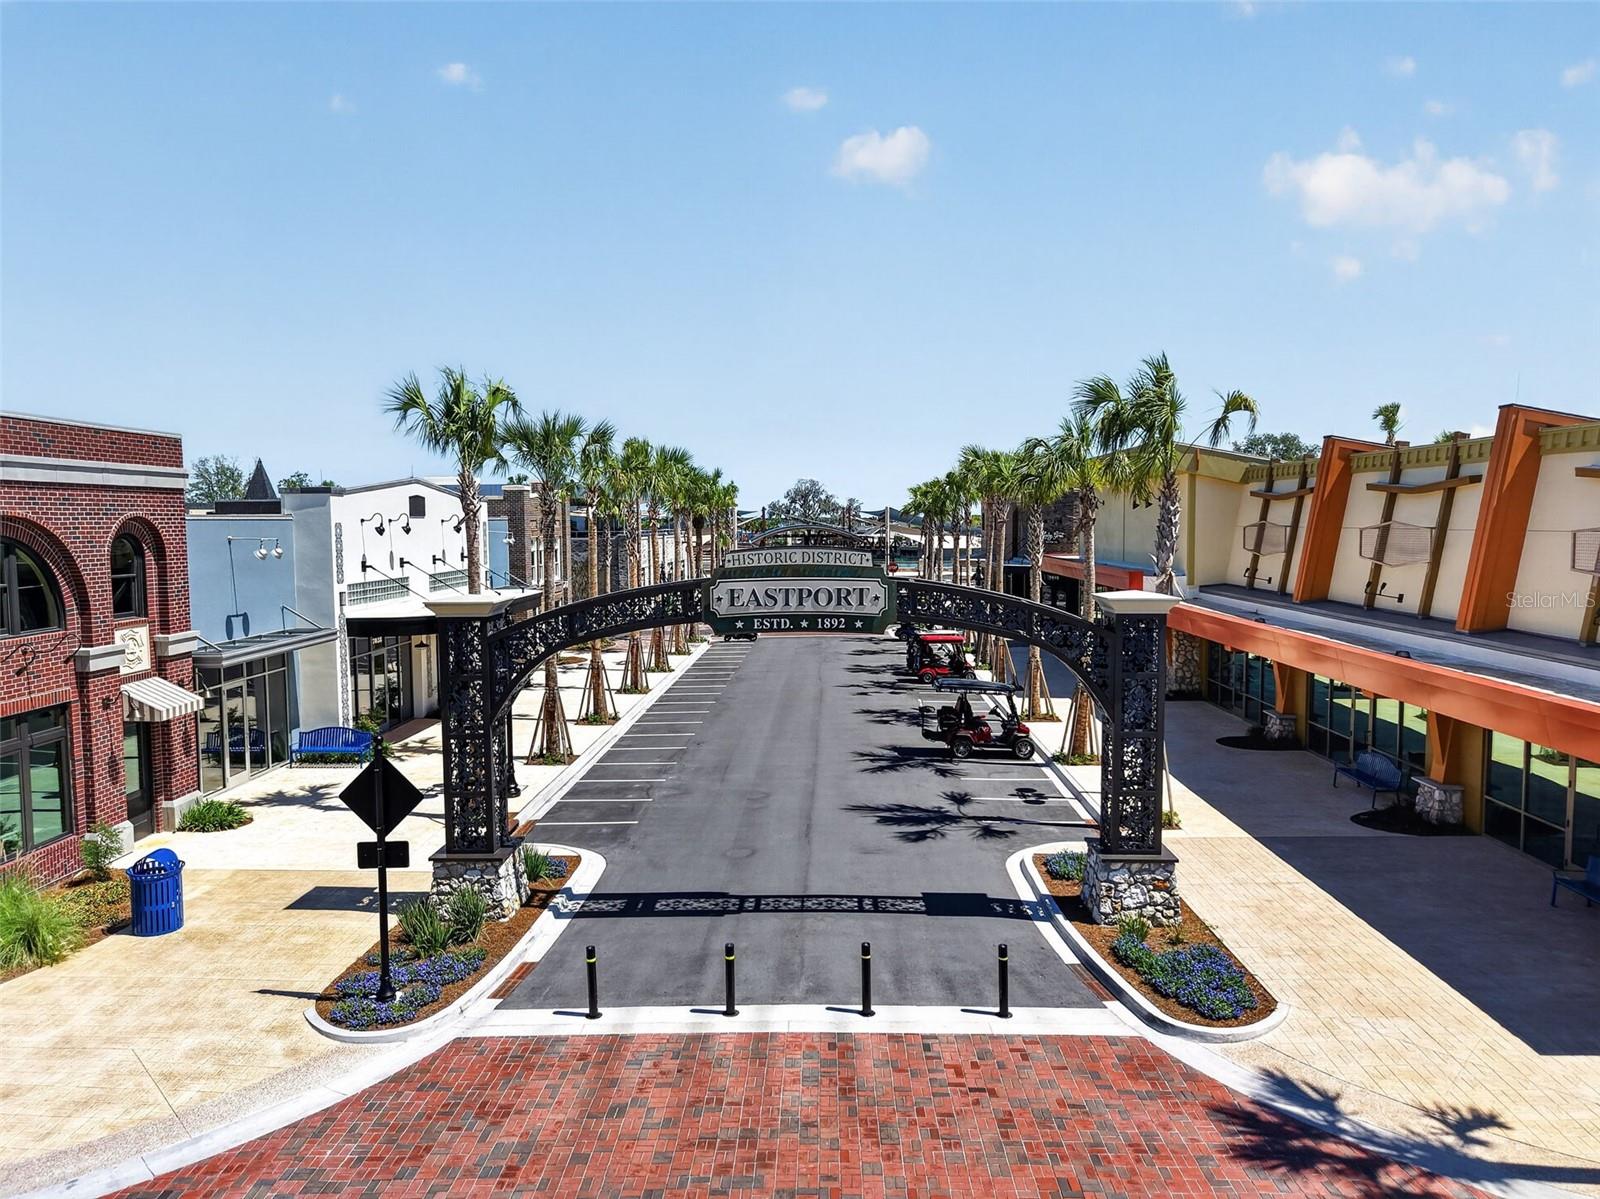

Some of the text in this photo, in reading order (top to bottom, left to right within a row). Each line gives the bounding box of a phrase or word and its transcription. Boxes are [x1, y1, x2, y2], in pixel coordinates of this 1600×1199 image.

[731, 551, 867, 567] HISTORIC DISTRICT
[727, 586, 871, 609] EASTPORT
[753, 618, 846, 630] ESTD. 1892
